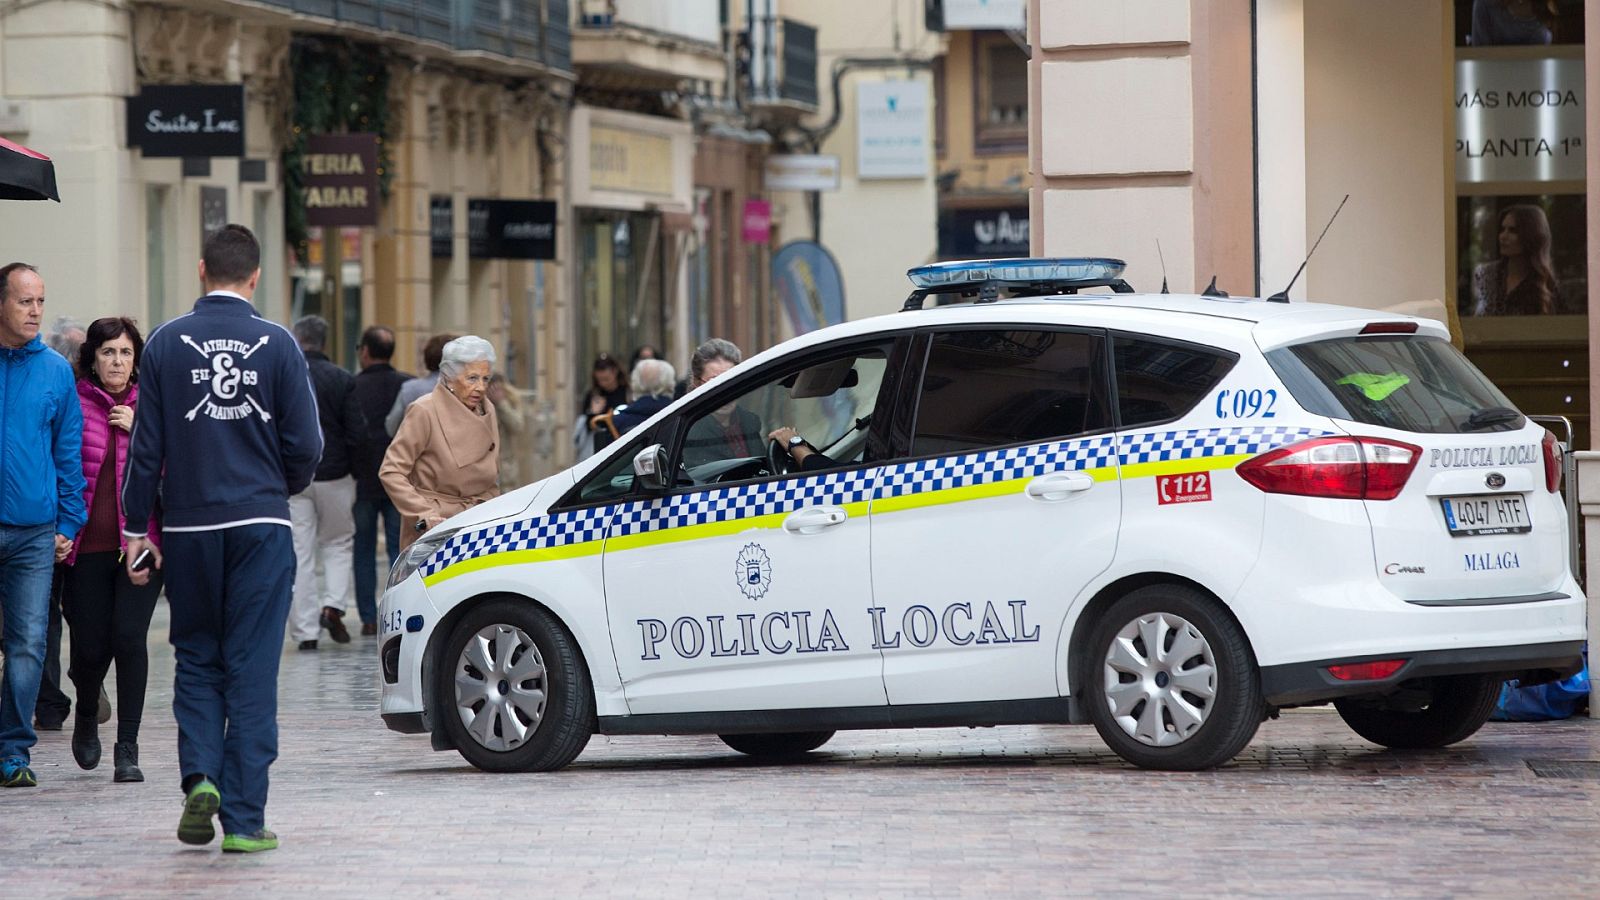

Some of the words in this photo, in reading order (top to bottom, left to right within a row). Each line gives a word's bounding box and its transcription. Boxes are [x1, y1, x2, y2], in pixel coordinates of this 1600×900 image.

[1506, 90, 1578, 108] MODA
[145, 109, 199, 132] Suits
[202, 109, 239, 132] Inc
[203, 339, 250, 354] ATHLETIC
[212, 352, 241, 400] &
[242, 370, 258, 386] 69
[204, 401, 253, 420] TRAINING
[1233, 389, 1277, 418] 092
[1429, 446, 1494, 468] POLICIA
[1499, 444, 1539, 466] LOCAL
[1173, 474, 1208, 494] 112
[1457, 501, 1490, 525] 4047
[1495, 499, 1521, 523] HTF
[1465, 551, 1521, 572] MALAGA
[637, 608, 849, 660] POLICIA
[867, 600, 1041, 649] LOCAL
